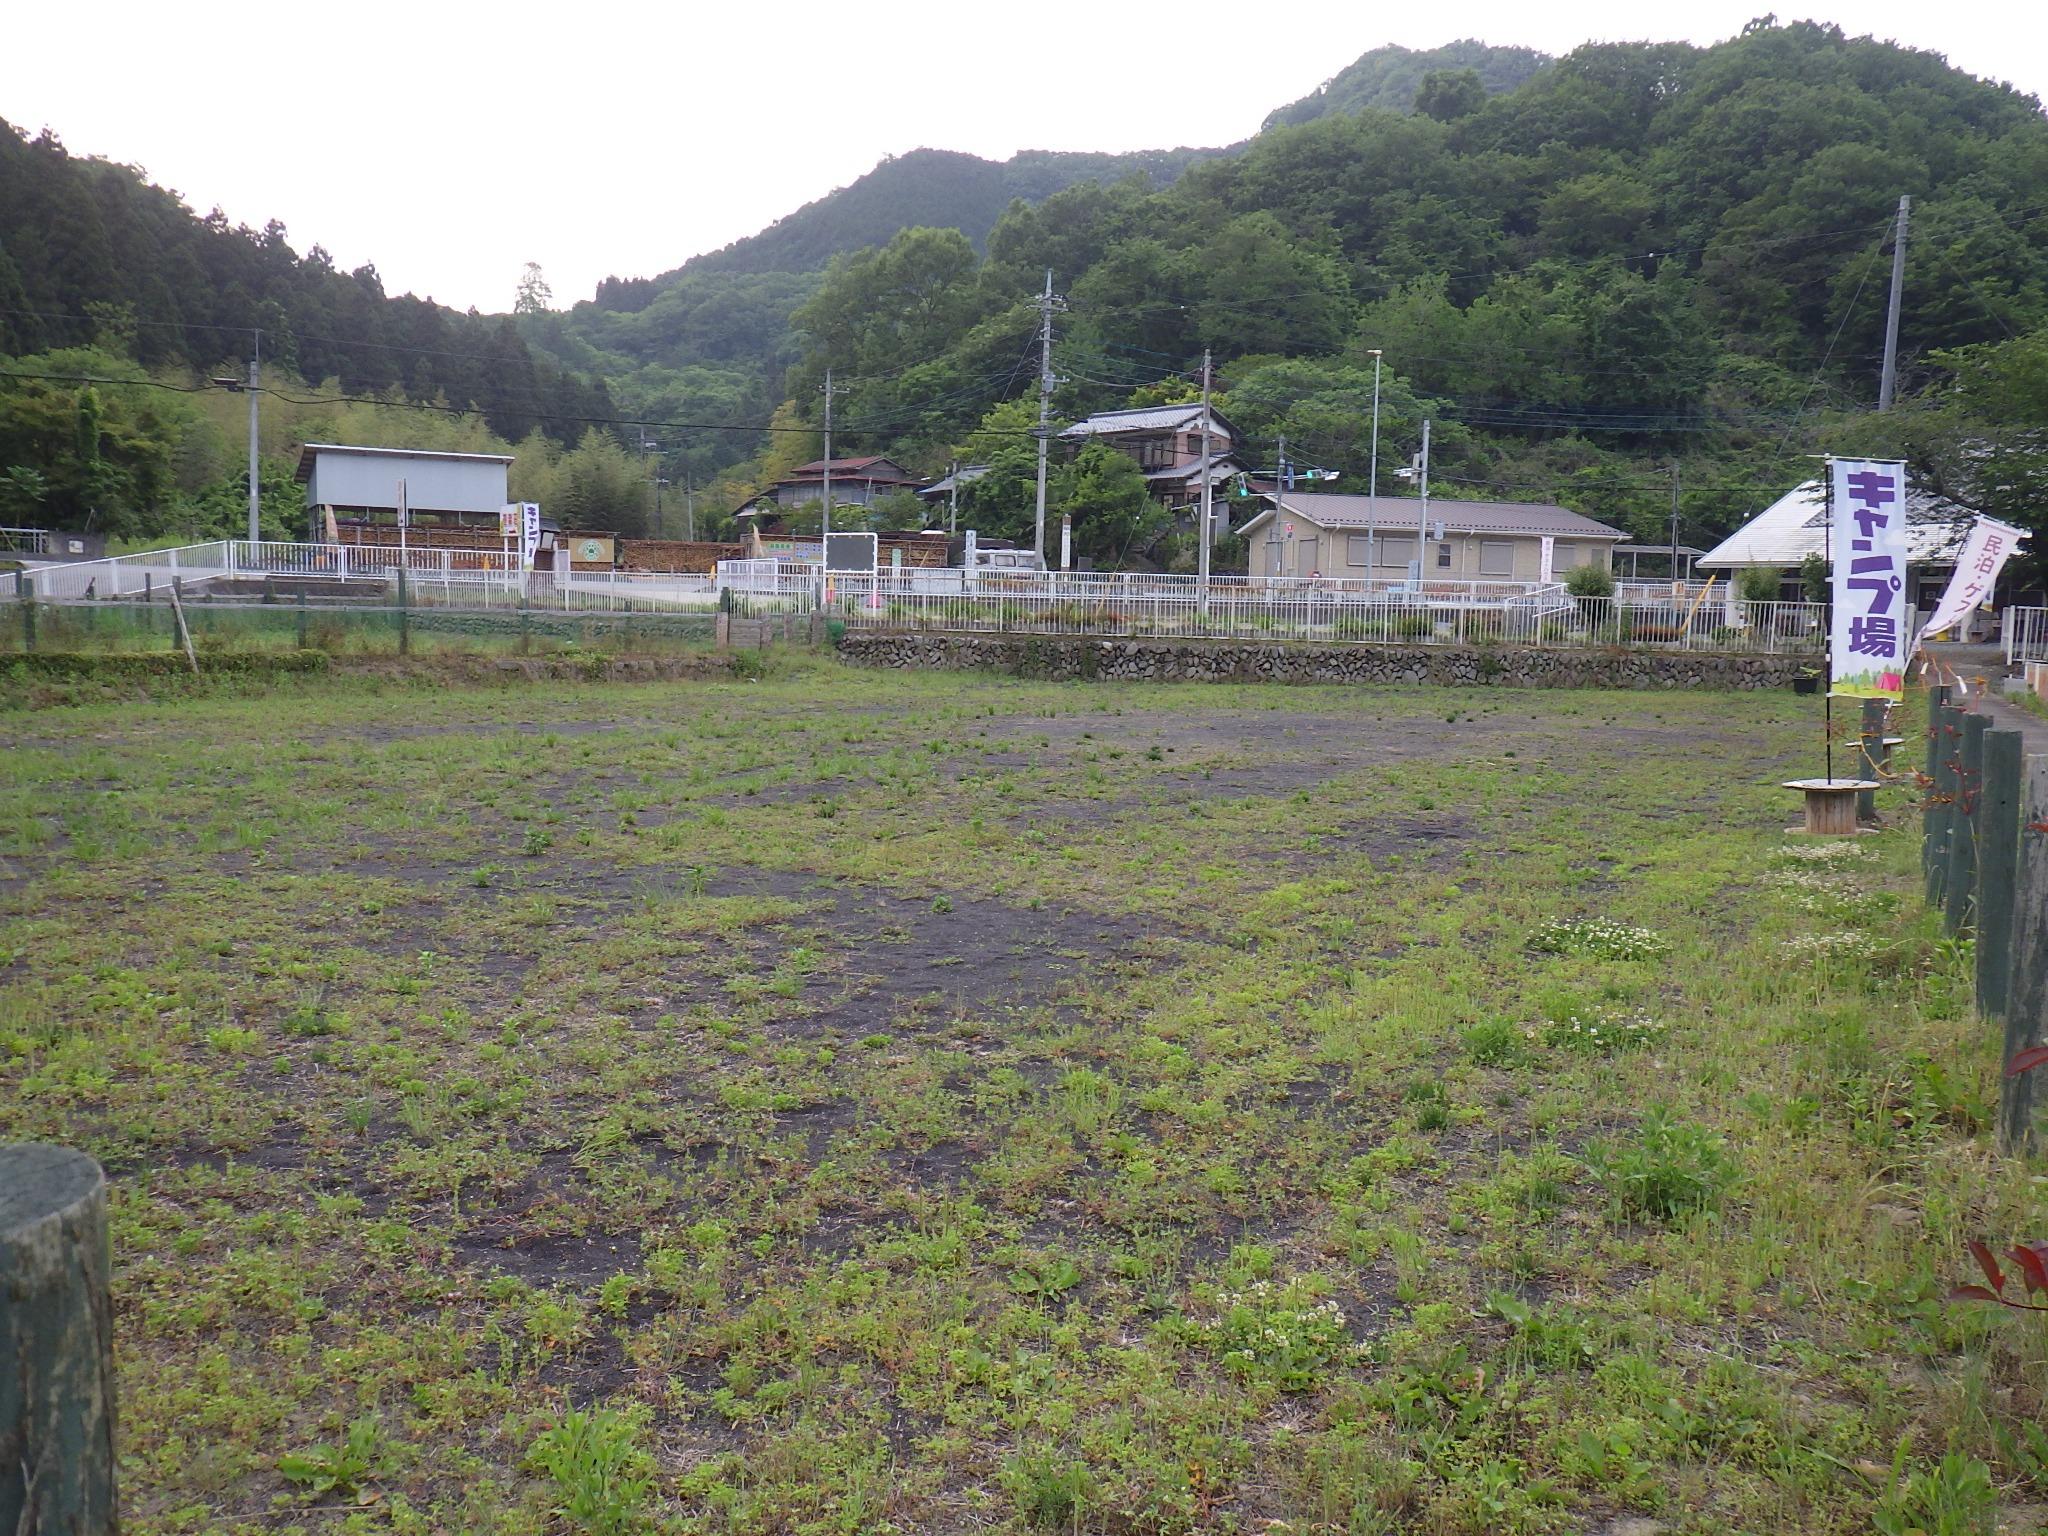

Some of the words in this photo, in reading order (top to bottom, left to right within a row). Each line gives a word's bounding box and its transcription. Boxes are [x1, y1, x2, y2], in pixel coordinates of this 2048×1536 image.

[1847, 471, 1902, 658] キャンプ場
